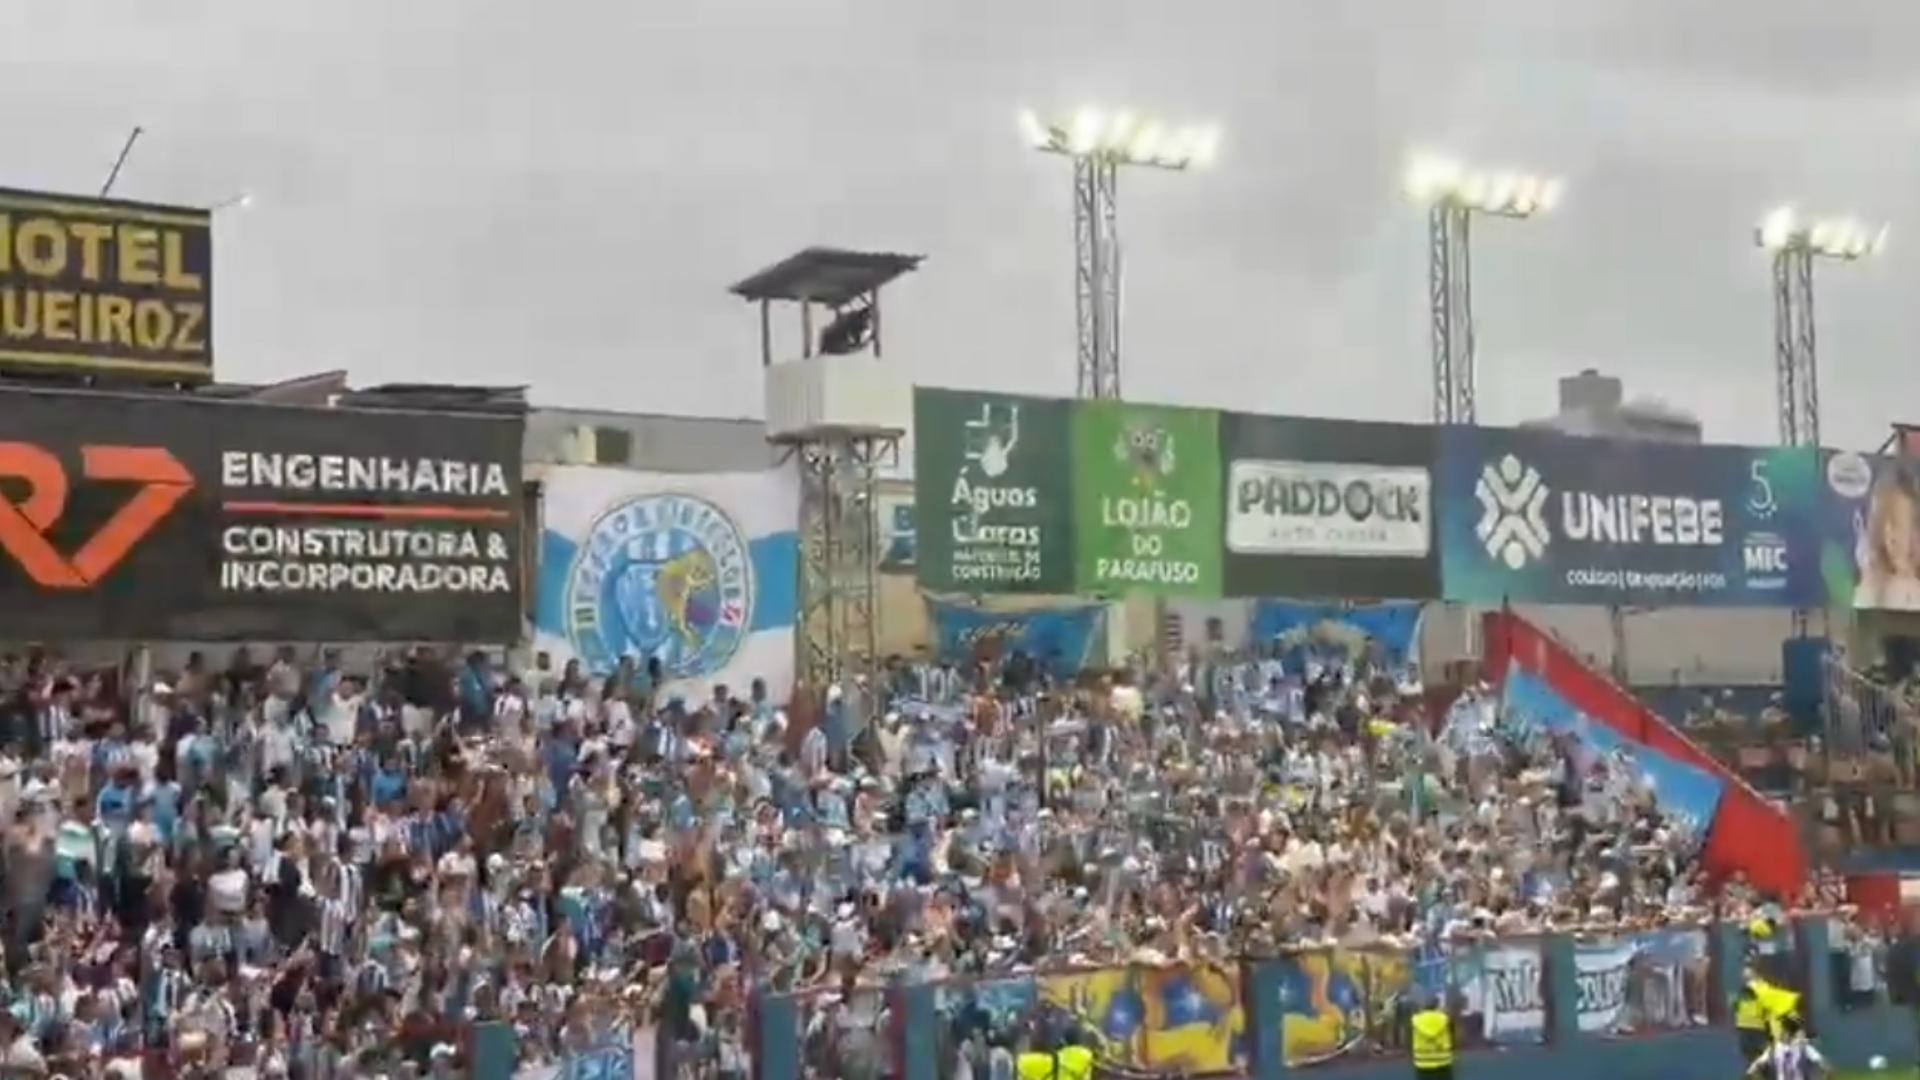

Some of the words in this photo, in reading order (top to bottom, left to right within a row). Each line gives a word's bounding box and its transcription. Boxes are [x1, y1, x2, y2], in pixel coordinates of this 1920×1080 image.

[0, 286, 206, 351] UEIROZ
[221, 450, 510, 497] ENGENHARIA
[951, 466, 1038, 514] Águas
[1751, 459, 1774, 510] 5
[1102, 489, 1192, 529] LOJÃO
[1236, 475, 1421, 523] PADDOCK
[1561, 490, 1725, 546] UNIFEBE
[222, 526, 480, 559] CONSTRUTORA
[486, 531, 509, 560] &
[1132, 534, 1163, 556] DO
[221, 560, 511, 593] INCORPORADORA
[1098, 557, 1200, 584] PARAFUSO
